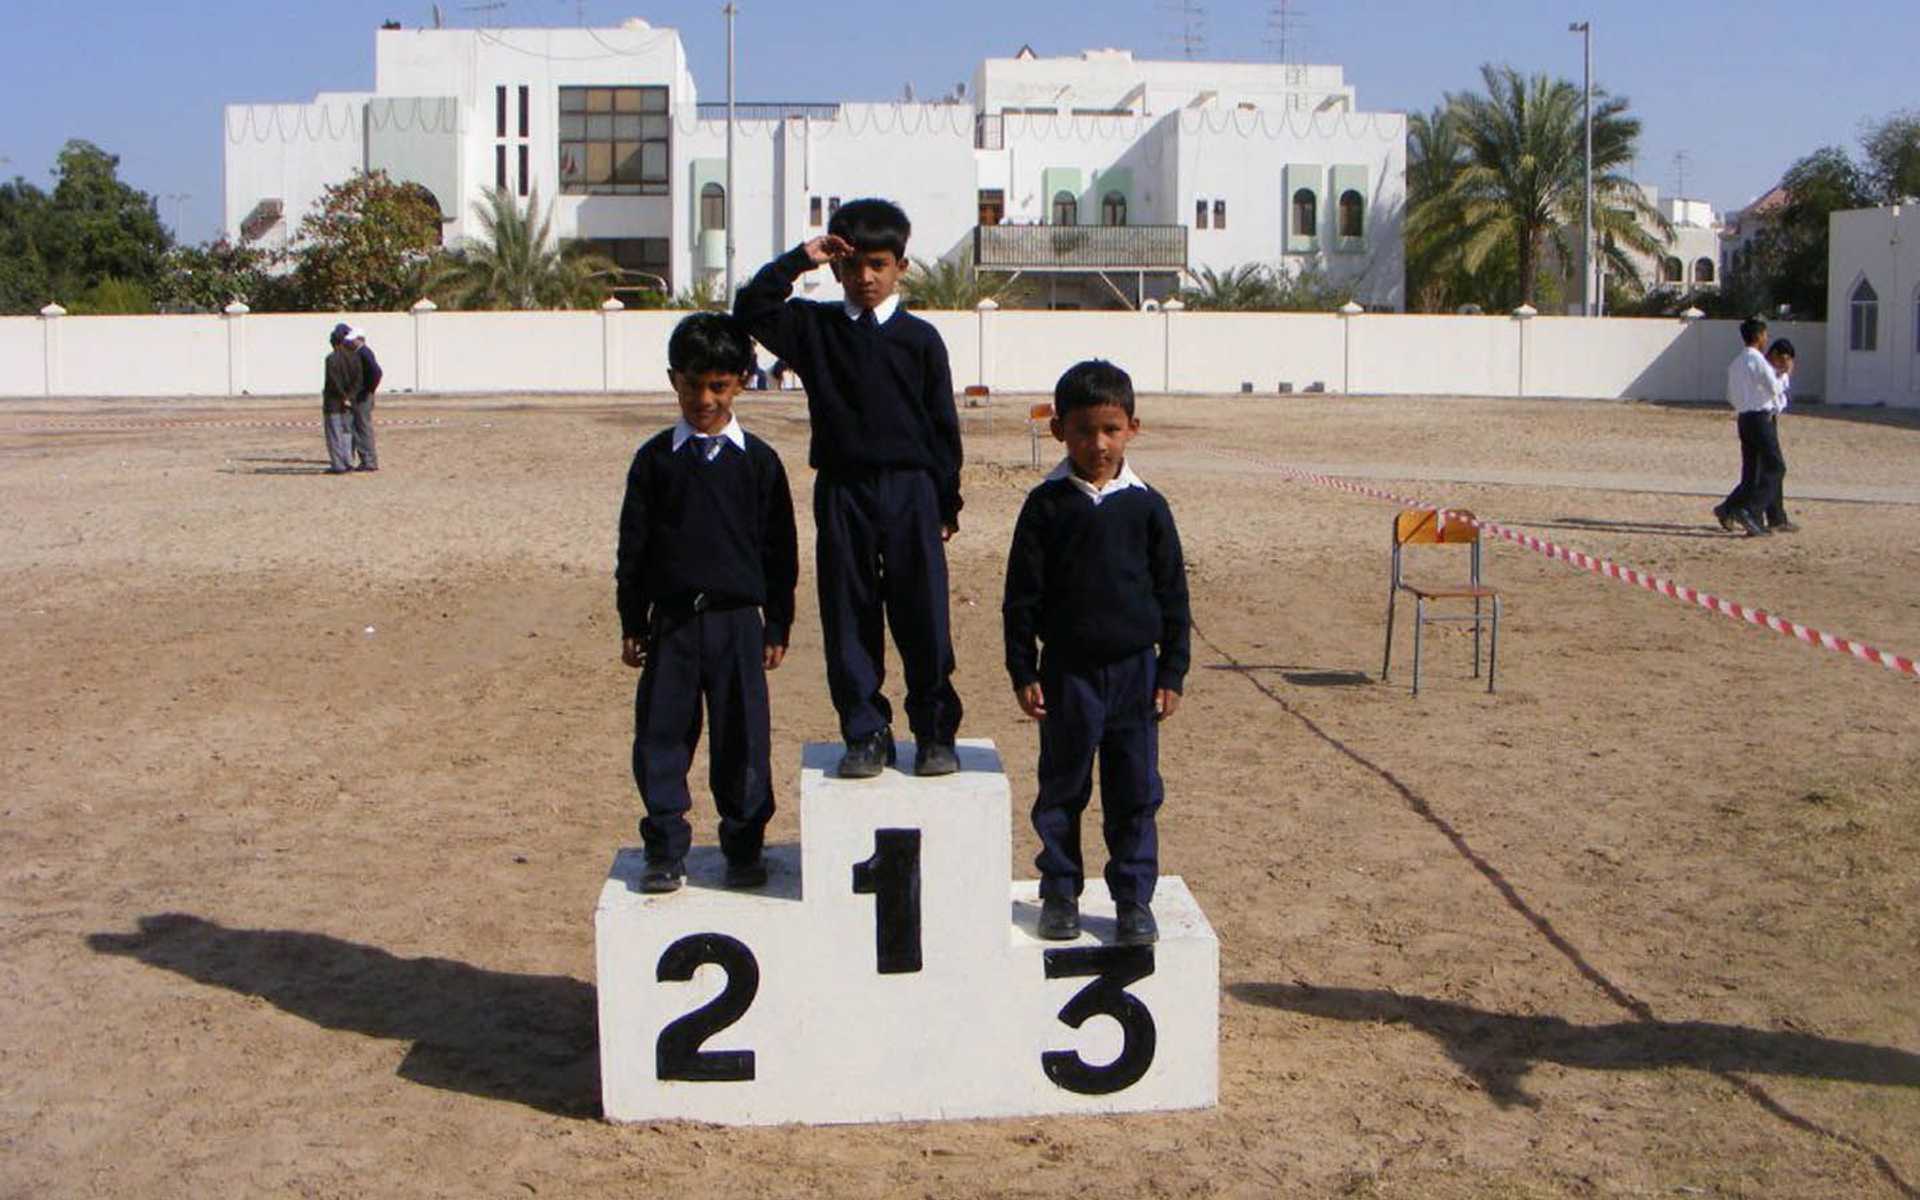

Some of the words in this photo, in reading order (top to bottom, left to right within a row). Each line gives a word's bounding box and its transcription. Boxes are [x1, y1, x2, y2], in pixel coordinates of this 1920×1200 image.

[852, 828, 923, 974] 1
[656, 932, 760, 1081] 2
[1041, 945, 1156, 1095] 3
